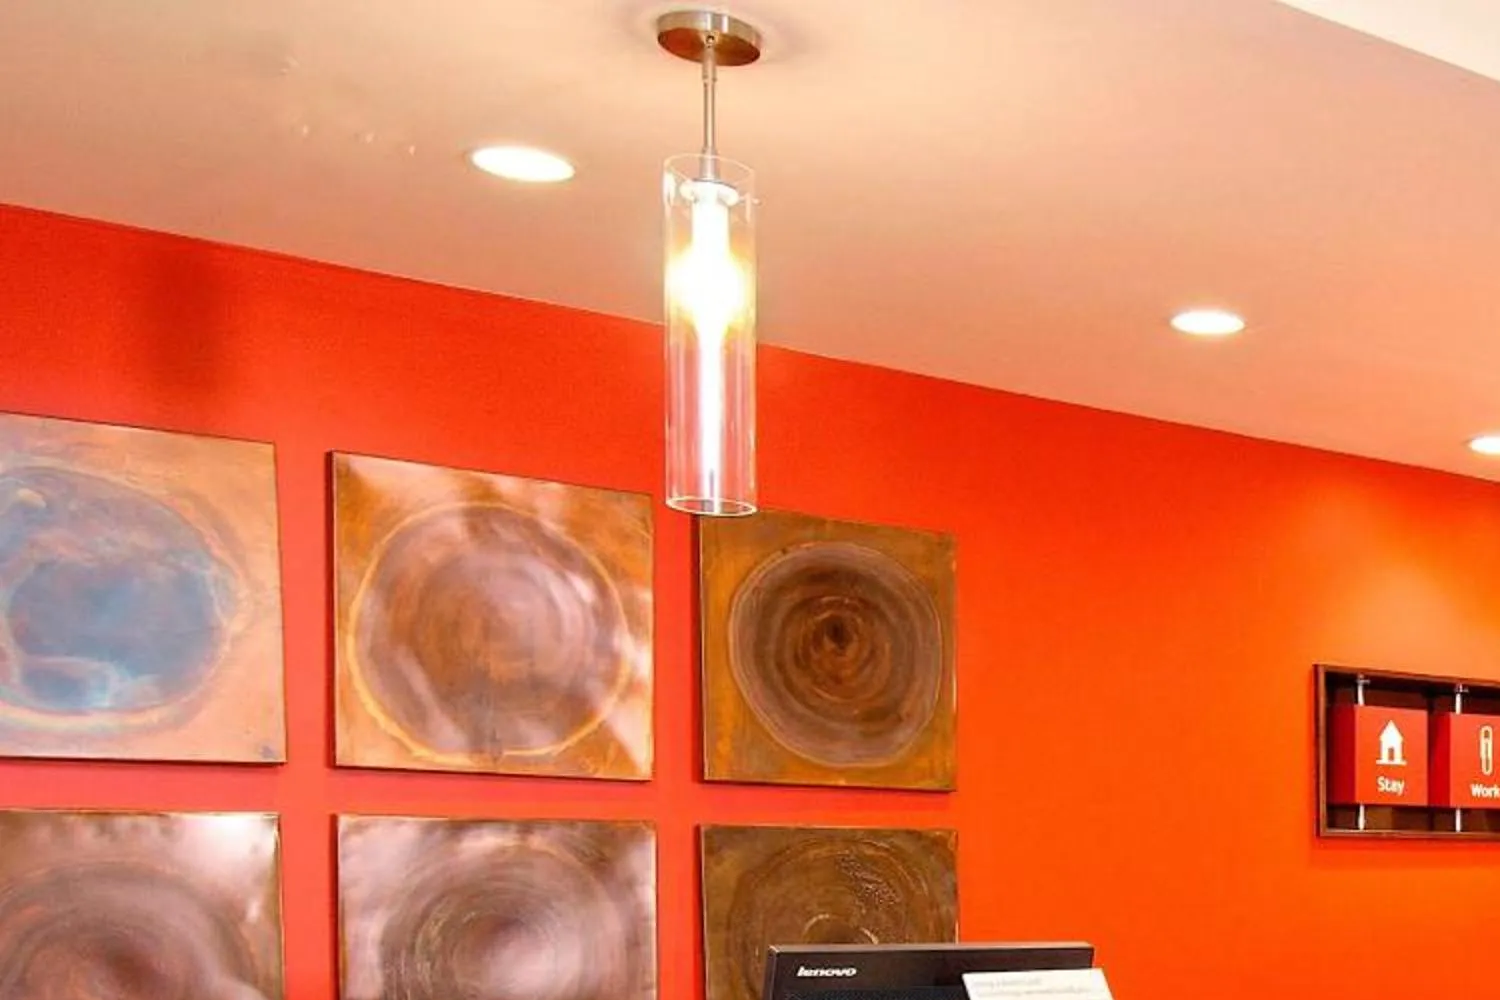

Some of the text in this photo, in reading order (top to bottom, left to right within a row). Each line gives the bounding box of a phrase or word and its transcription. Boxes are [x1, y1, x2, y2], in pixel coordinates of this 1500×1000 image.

[1377, 775, 1405, 796] Stay
[1471, 784, 1500, 798] Work
[797, 965, 857, 977] lenovo
